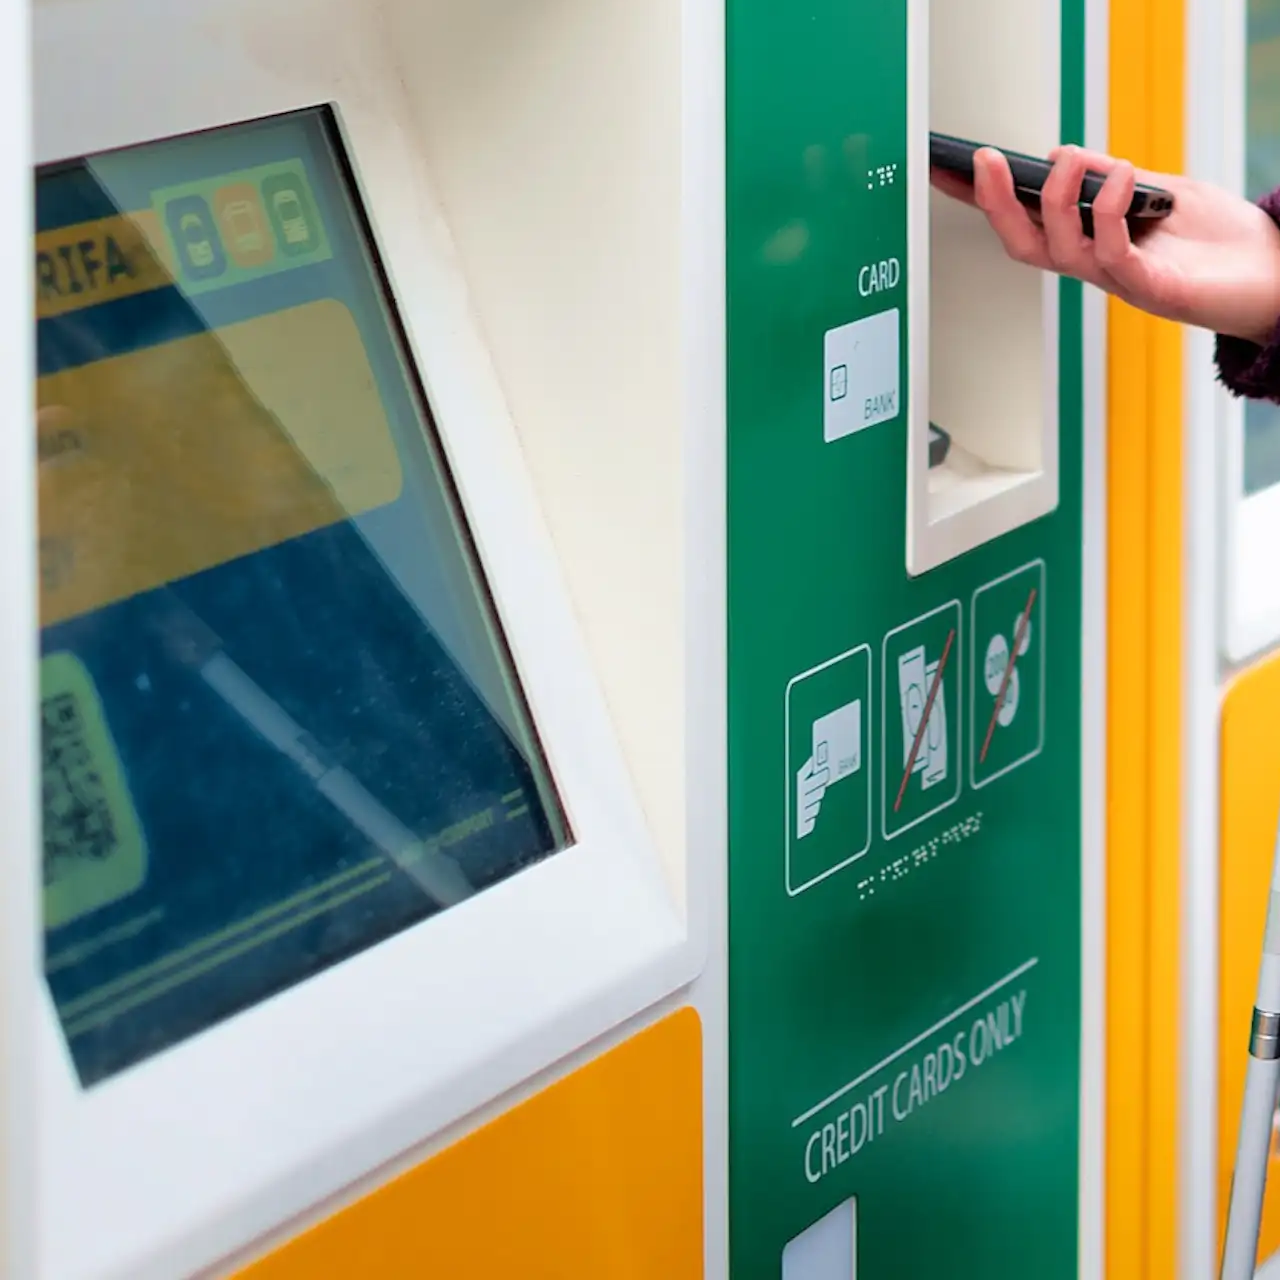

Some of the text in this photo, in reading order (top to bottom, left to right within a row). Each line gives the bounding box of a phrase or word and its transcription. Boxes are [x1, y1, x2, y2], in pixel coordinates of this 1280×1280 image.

[858, 257, 900, 297] CARD
[864, 391, 896, 420] BANK
[804, 989, 1027, 1184] CREDIT CARDS ONLY
